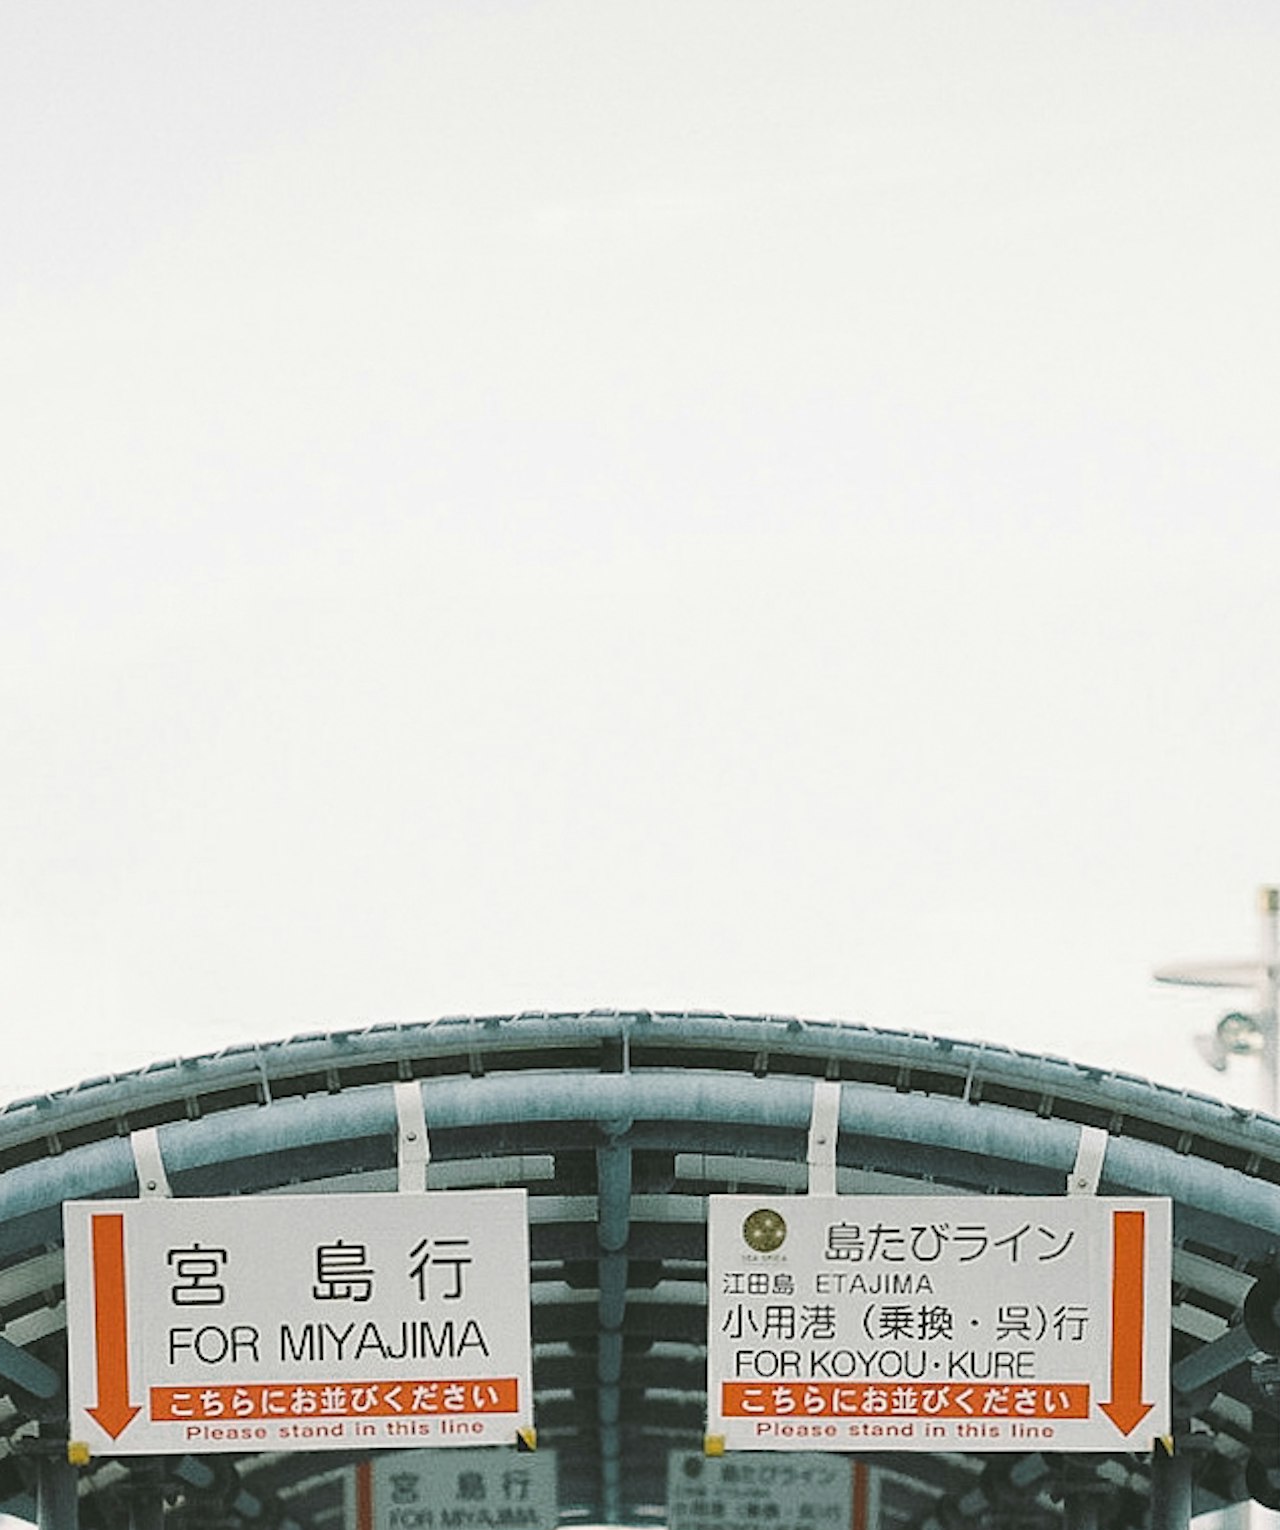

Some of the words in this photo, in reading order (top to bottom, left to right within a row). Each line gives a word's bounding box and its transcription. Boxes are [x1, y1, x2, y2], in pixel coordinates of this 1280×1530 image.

[824, 1222, 1074, 1262] 島たびライン
[168, 1239, 471, 1305] 宮島行
[722, 1272, 795, 1295] 江田島
[816, 1273, 934, 1295] ETAJIMA
[170, 1326, 259, 1364] FOR
[280, 1321, 489, 1361] MIYAJIMA
[735, 1350, 801, 1378] FOR
[170, 1383, 499, 1416] こちらにお並びください
[741, 1386, 1071, 1415] こちらにお並びください
[186, 1425, 267, 1441] Please
[279, 1422, 344, 1438] stand
[355, 1421, 376, 1437] in
[387, 1420, 429, 1436] this
[441, 1419, 484, 1435] line
[756, 1423, 837, 1438] Please
[849, 1423, 914, 1438] stand
[925, 1423, 946, 1438] in
[956, 1423, 1000, 1438] this
[1011, 1423, 1055, 1438] line
